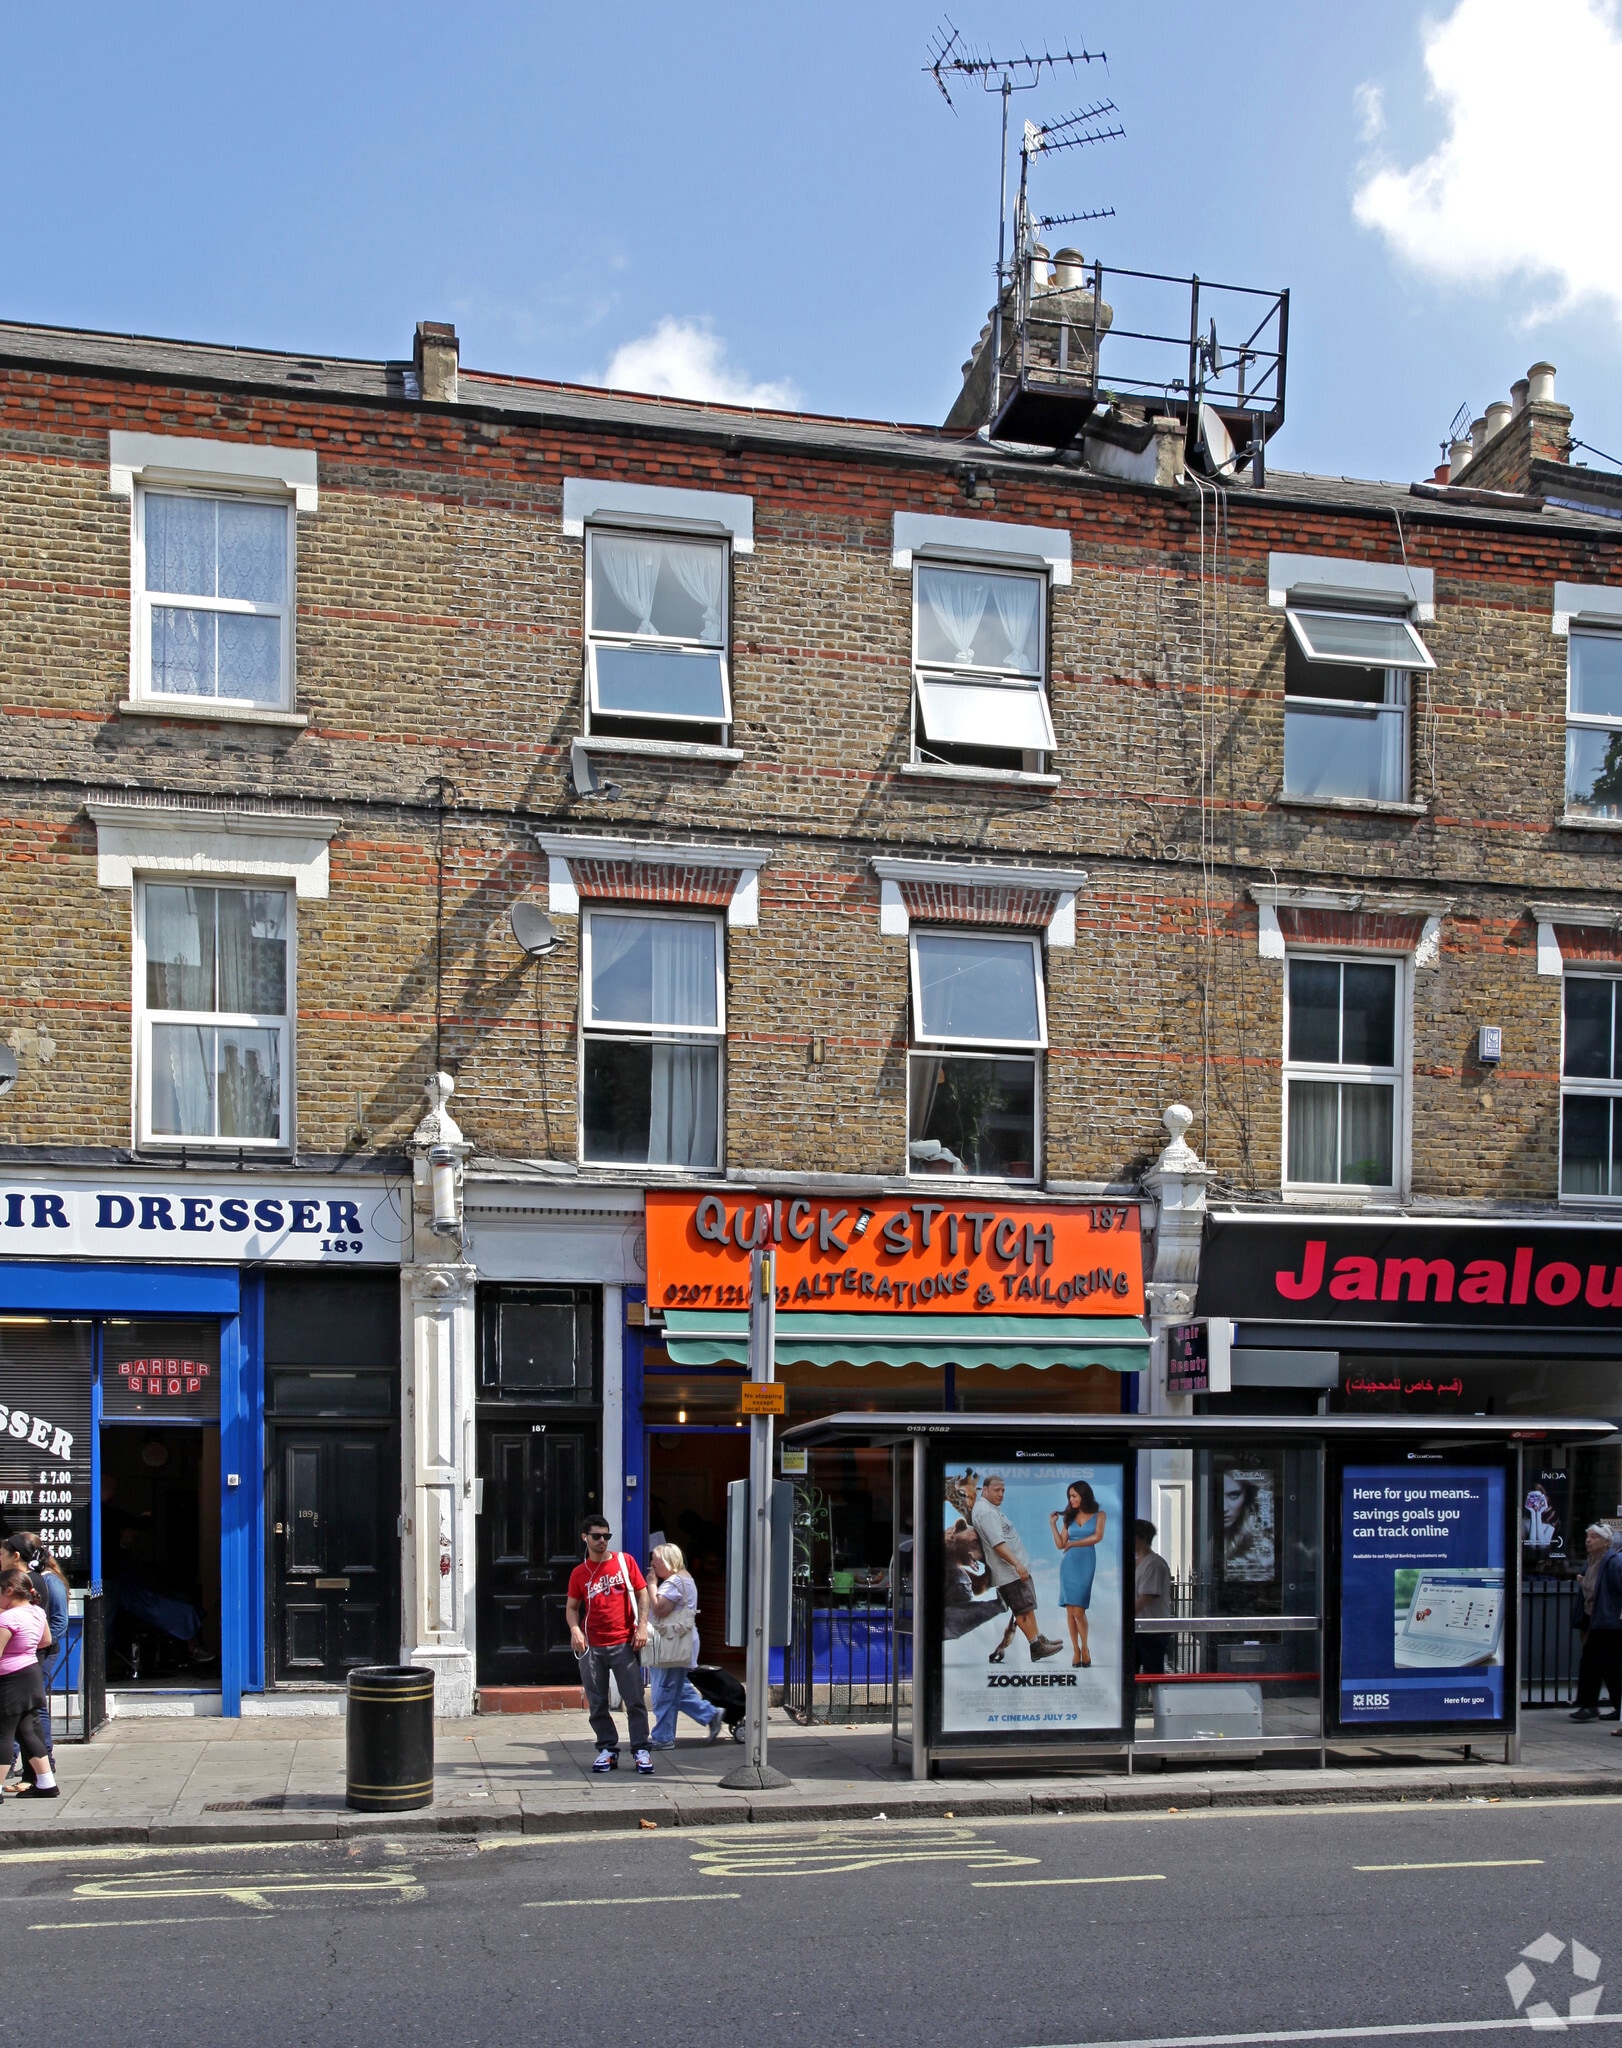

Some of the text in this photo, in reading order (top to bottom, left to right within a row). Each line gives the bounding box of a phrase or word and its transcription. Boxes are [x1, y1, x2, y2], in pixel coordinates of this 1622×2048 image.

[0, 1193, 364, 1234] IR DRESSER
[1088, 1206, 1129, 1232] 187
[695, 1195, 1054, 1265] QUICK STITCH
[319, 1239, 364, 1255] 189
[667, 1284, 713, 1303] 0207
[795, 1266, 970, 1303] ALTERATIONS
[977, 1281, 996, 1305] &
[1003, 1265, 1130, 1305] TAILORING
[1178, 1325, 1199, 1340] Hair
[1184, 1341, 1192, 1355] &
[119, 1358, 210, 1376] BARBER
[1170, 1356, 1206, 1372] Beauty
[129, 1376, 200, 1395] SHOP
[531, 1424, 547, 1433] 187
[974, 1467, 1095, 1479] KEVIN JAMES
[12, 1489, 34, 1504] DRY
[39, 1490, 72, 1504] £10.00
[1353, 1487, 1480, 1502] Here for you means...
[39, 1508, 72, 1523] £5.00
[298, 1509, 313, 1518] 189
[1353, 1507, 1461, 1522] savings goals you
[39, 1528, 72, 1542] £5.00
[1353, 1525, 1449, 1538] can track online
[987, 1674, 1078, 1688] ZOOKEEPER
[1366, 1693, 1390, 1706] RBS
[1460, 1696, 1471, 1704] for
[1471, 1697, 1485, 1705] you
[987, 1713, 1078, 1722] AT CINEMAS JULY 29
